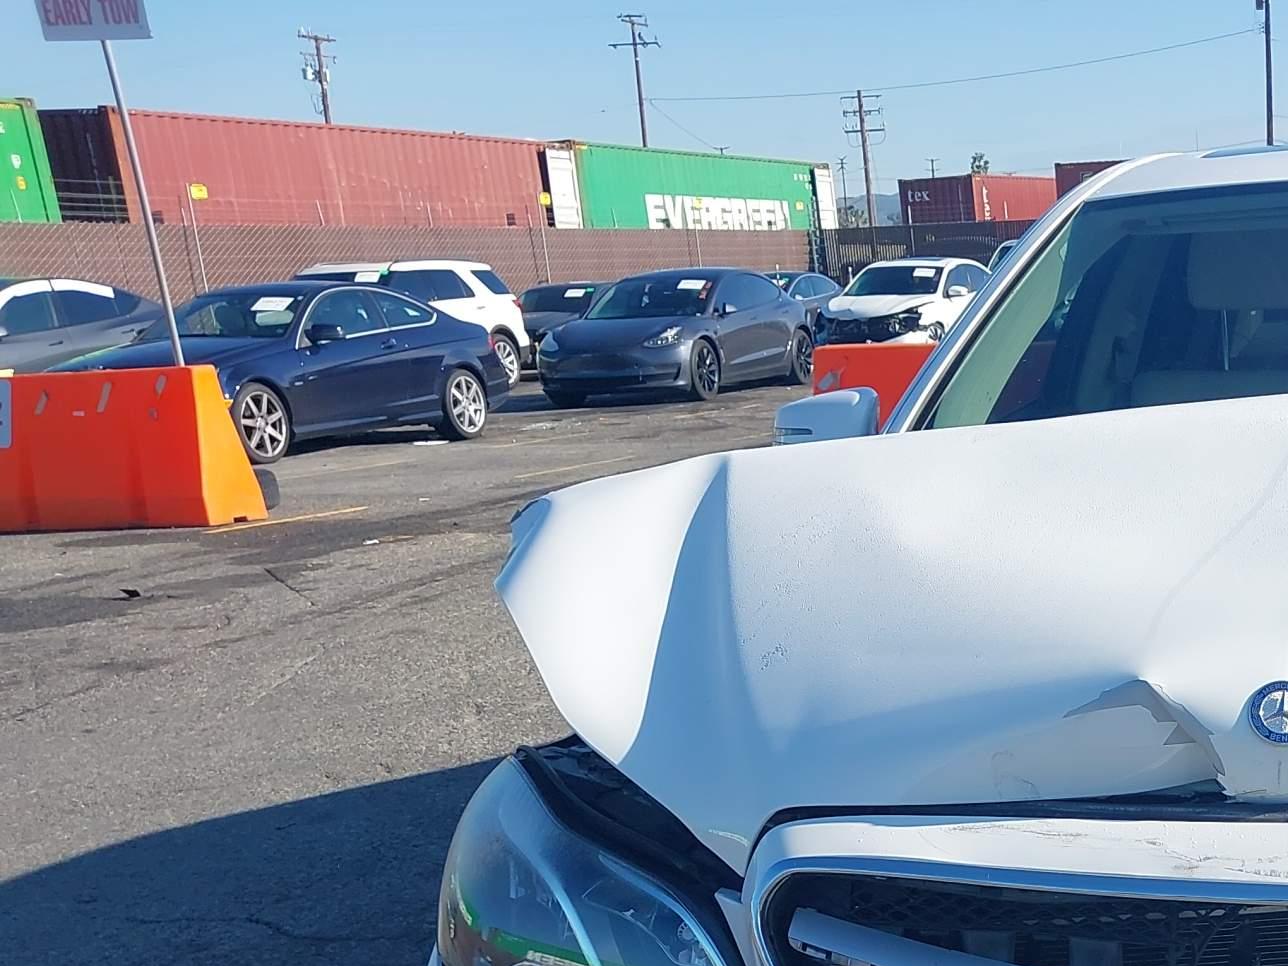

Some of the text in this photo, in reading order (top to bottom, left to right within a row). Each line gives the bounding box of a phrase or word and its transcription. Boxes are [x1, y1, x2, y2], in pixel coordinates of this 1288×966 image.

[41, 0, 139, 25] EARLY TOW
[907, 189, 930, 203] tex
[645, 193, 791, 230] EVERGREEN
